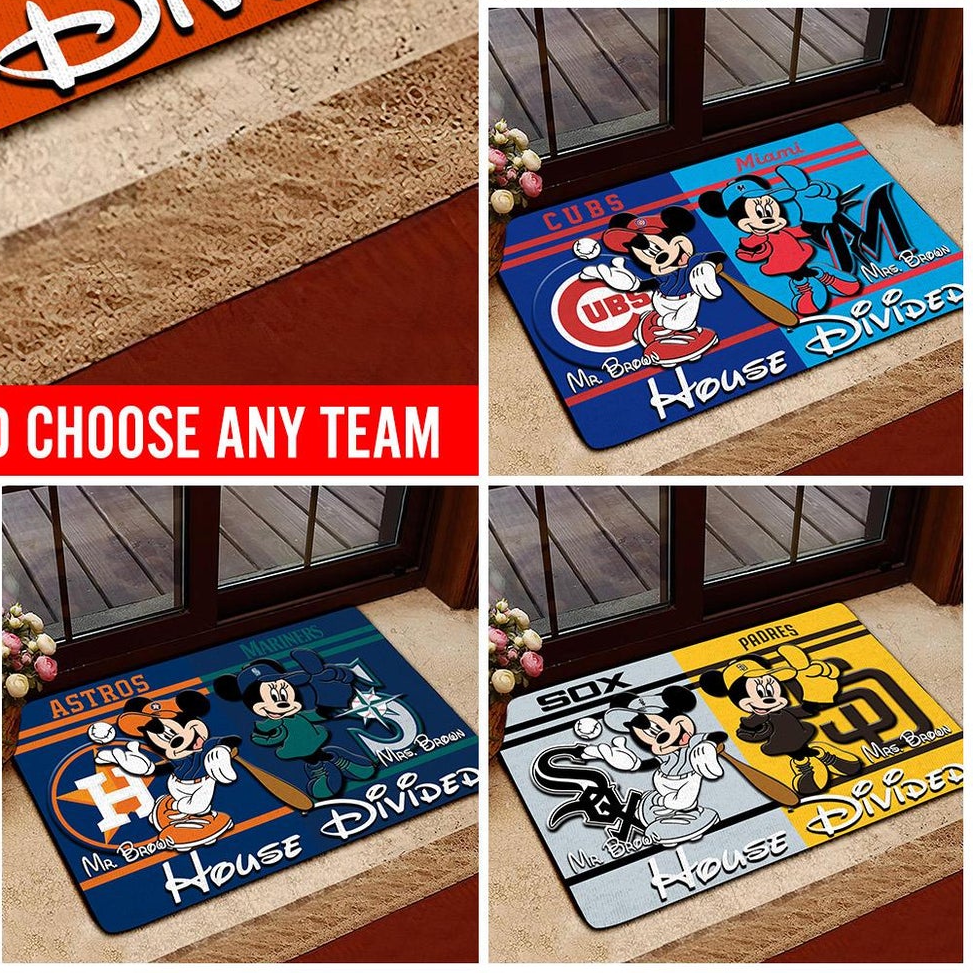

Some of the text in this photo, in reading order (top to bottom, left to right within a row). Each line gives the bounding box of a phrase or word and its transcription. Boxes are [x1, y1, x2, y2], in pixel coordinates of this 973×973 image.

[735, 141, 805, 174] Miami
[541, 193, 625, 232] CUBS
[647, 350, 788, 422] HOUSE
[239, 625, 325, 659] MARINERS
[738, 623, 800, 652] PADRES
[46, 674, 152, 719] ASTROS
[536, 671, 633, 712] SOX
[73, 767, 155, 833] H
[162, 833, 303, 905] HOUSE
[649, 829, 790, 903] HOUSE
